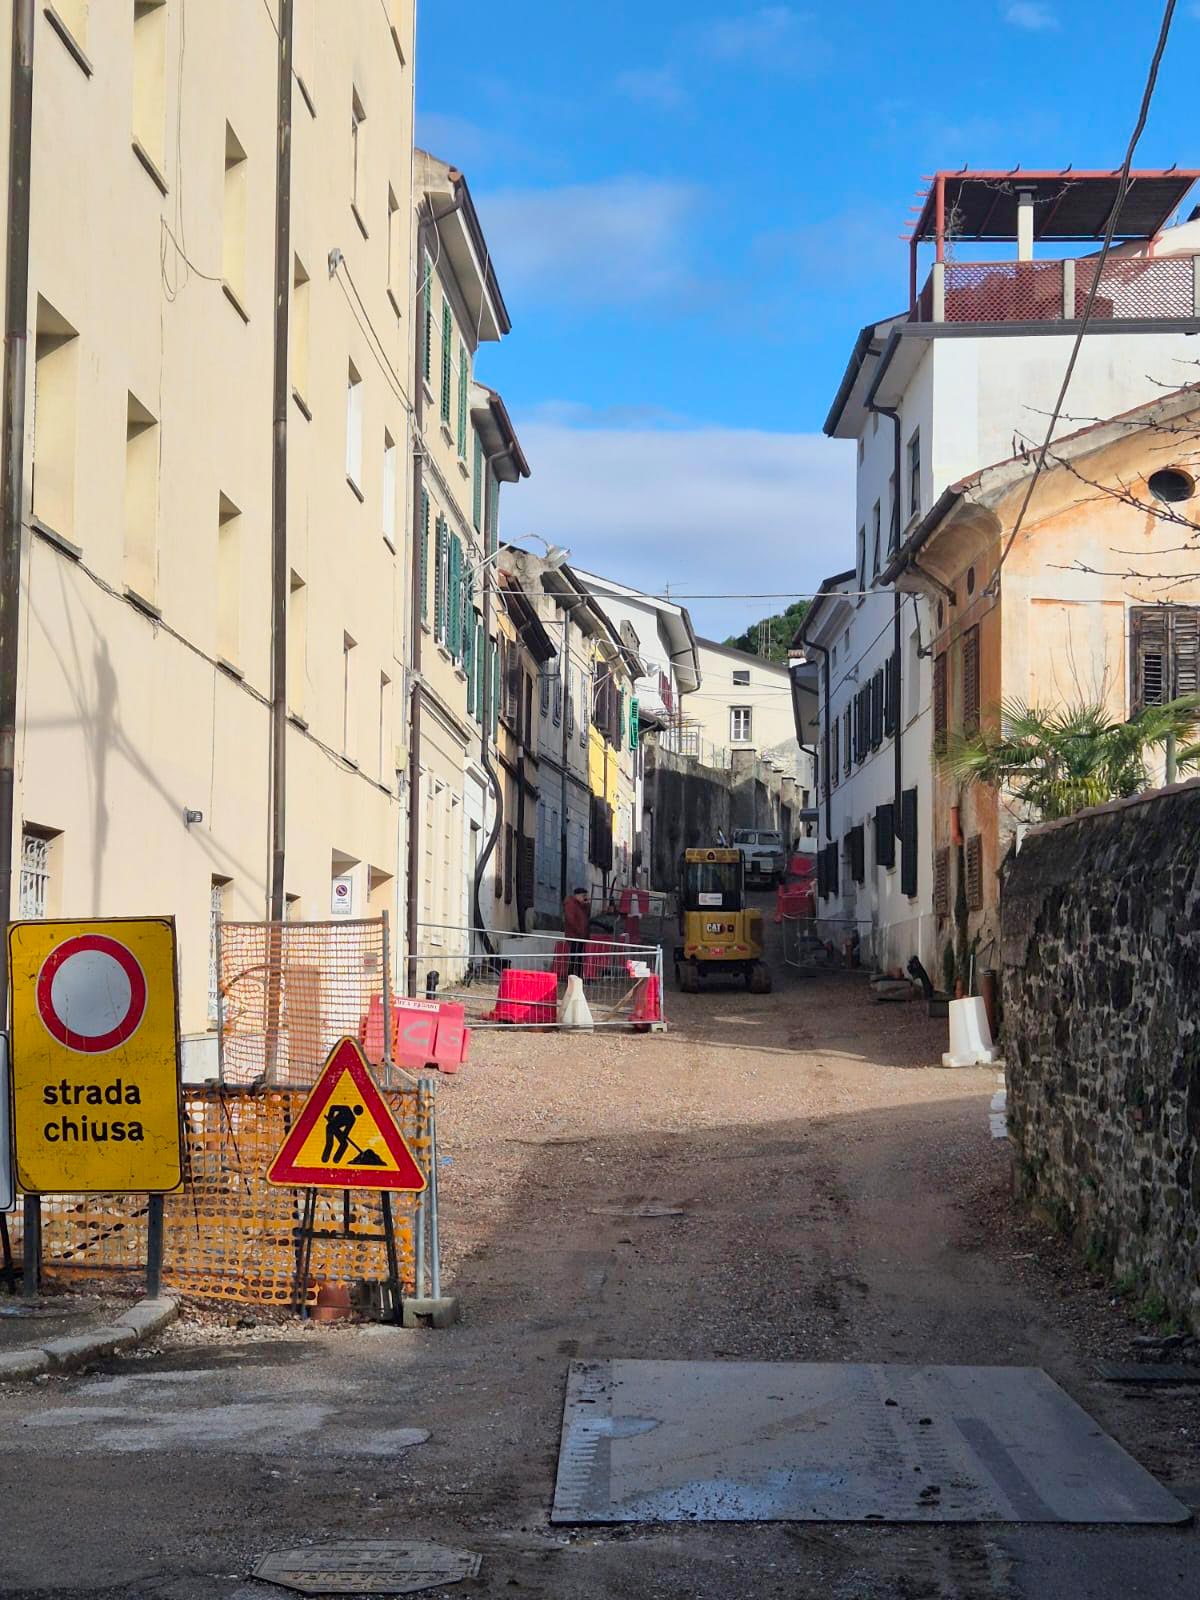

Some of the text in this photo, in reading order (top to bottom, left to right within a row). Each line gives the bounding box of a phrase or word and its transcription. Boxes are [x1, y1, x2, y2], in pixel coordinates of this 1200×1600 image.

[706, 923, 721, 932] CAT
[43, 1078, 141, 1105] strada
[44, 1115, 145, 1142] chiusa
